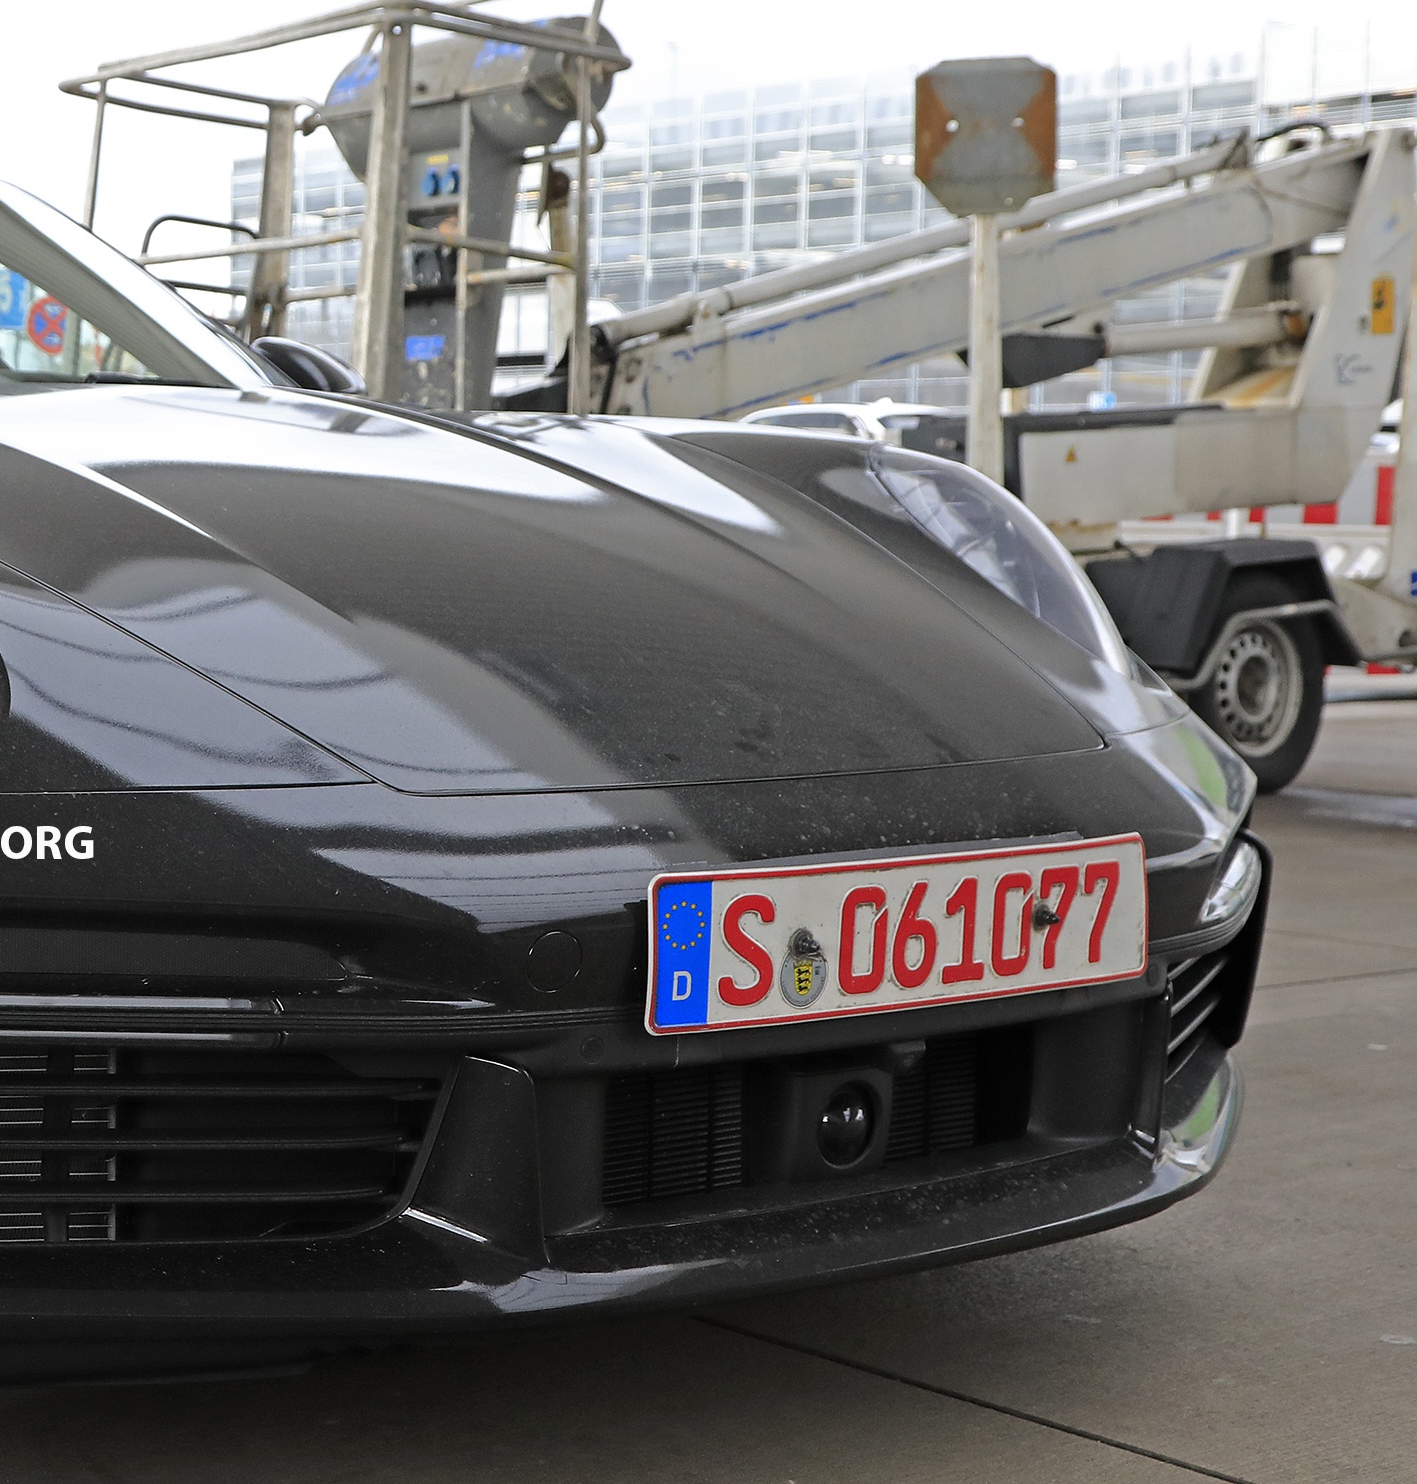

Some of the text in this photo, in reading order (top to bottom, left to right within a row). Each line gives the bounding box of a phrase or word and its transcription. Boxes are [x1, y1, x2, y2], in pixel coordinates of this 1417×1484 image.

[718, 893, 775, 1007] S
[838, 860, 1120, 995] 061077
[671, 970, 692, 1002] D
